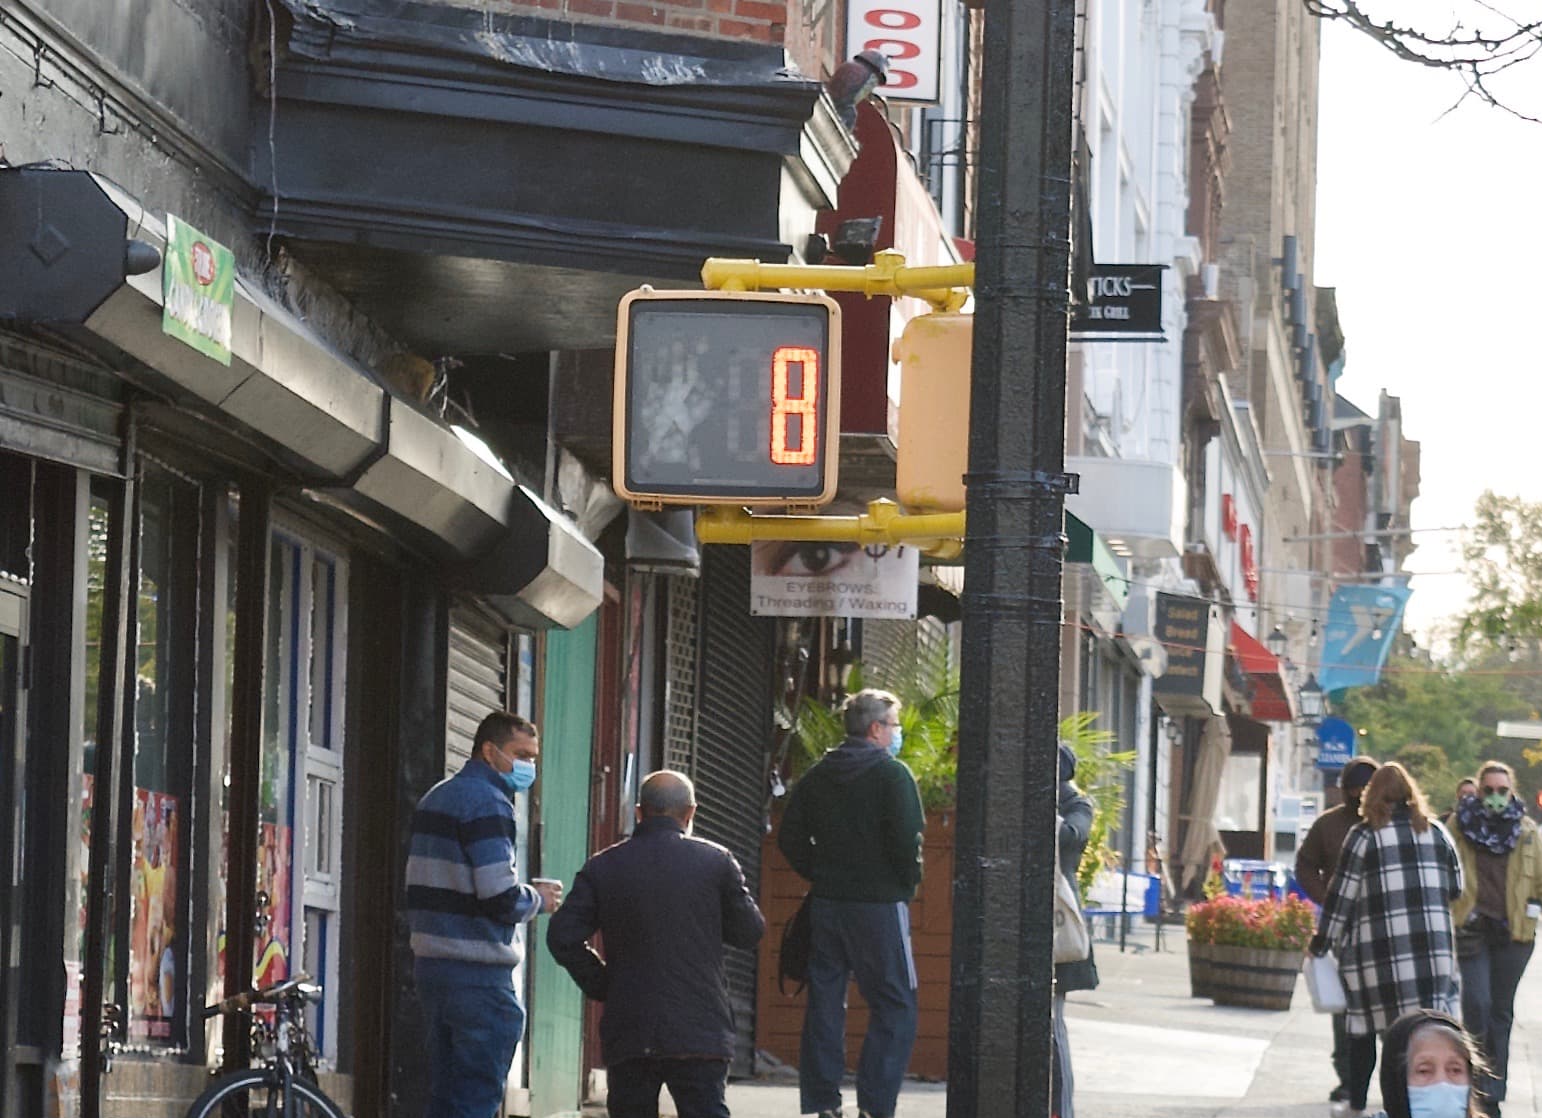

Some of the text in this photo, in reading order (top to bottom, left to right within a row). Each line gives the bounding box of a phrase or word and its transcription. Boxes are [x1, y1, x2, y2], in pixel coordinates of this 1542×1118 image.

[771, 347, 818, 465] 8
[786, 582, 874, 594] EYEBROWS
[757, 596, 834, 610] Threading
[846, 597, 908, 613] Waxing
